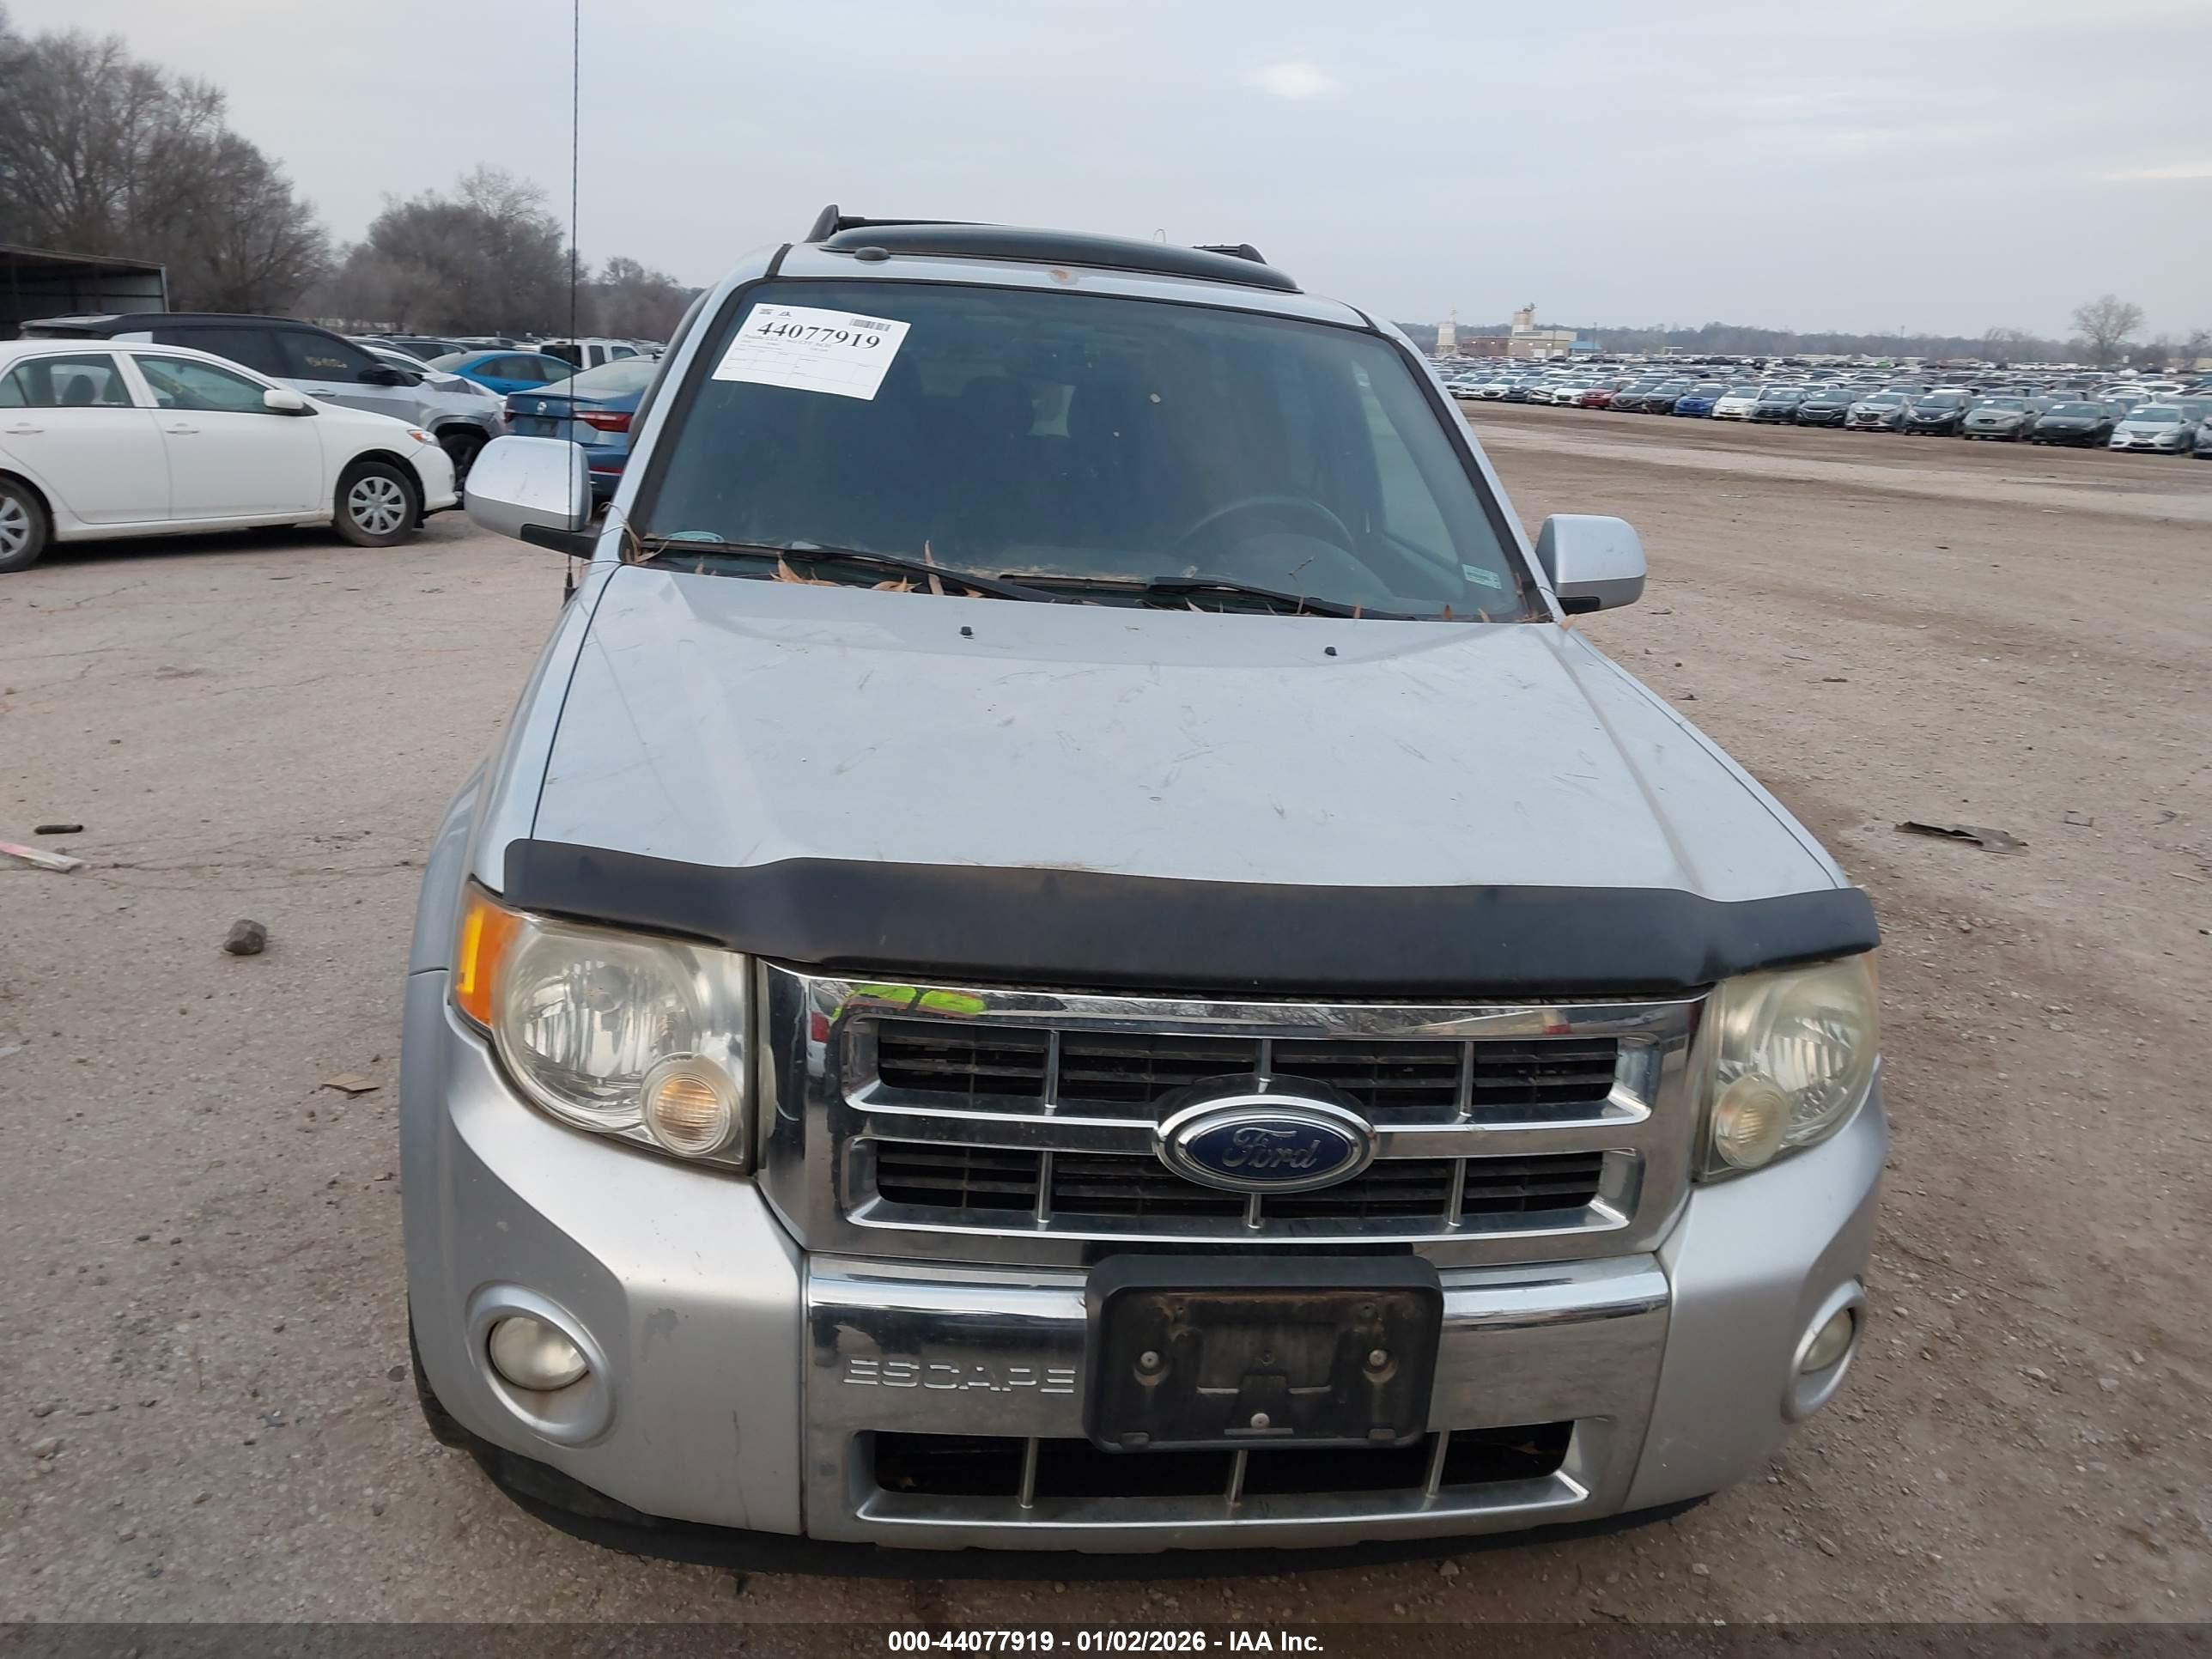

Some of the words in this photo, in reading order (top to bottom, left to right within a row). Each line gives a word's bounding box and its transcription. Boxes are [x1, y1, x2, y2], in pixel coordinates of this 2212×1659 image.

[757, 321, 880, 349] 44077919
[1222, 1127, 1321, 1169] Ford
[843, 1359, 1076, 1394] ESCAPE
